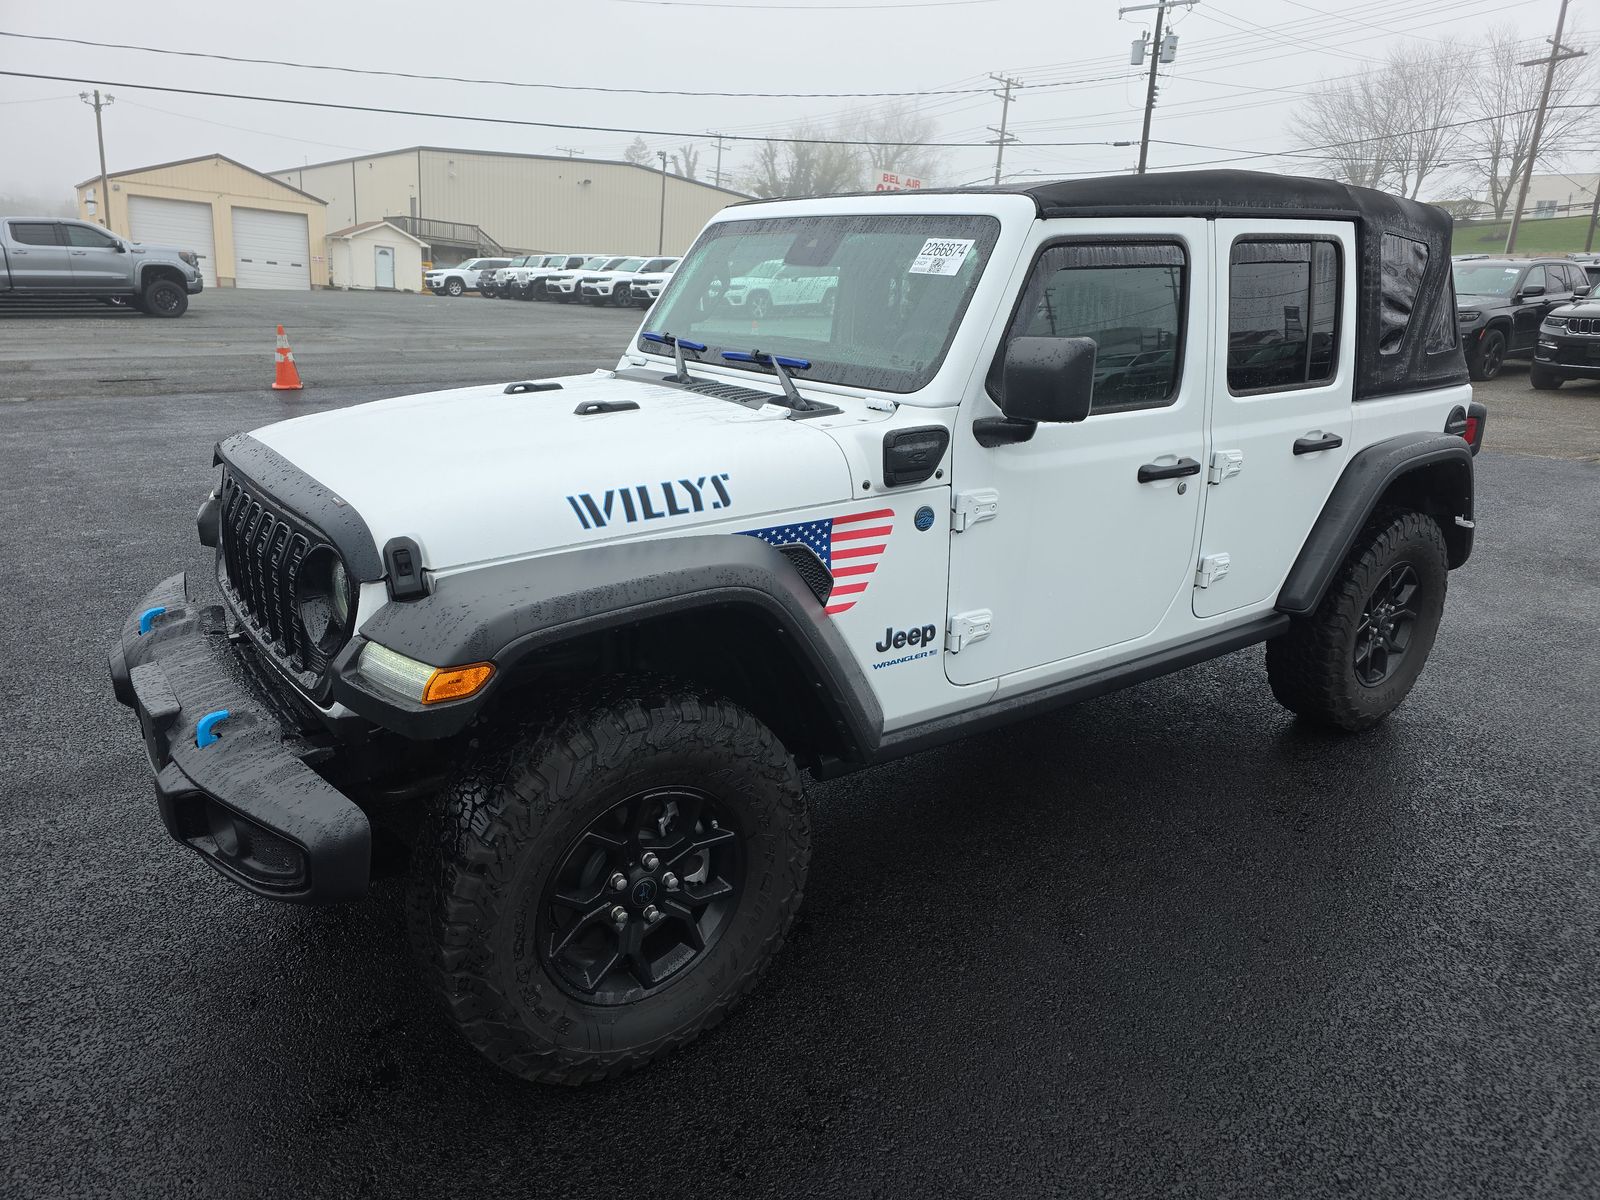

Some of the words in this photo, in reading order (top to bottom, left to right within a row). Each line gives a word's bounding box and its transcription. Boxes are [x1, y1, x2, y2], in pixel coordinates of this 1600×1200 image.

[882, 173, 900, 184] BEL
[905, 178, 921, 189] AIR
[921, 242, 968, 257] 2266874
[566, 473, 731, 530] WILLYS
[875, 624, 937, 653] Jeep
[872, 651, 929, 670] WRANGLER
